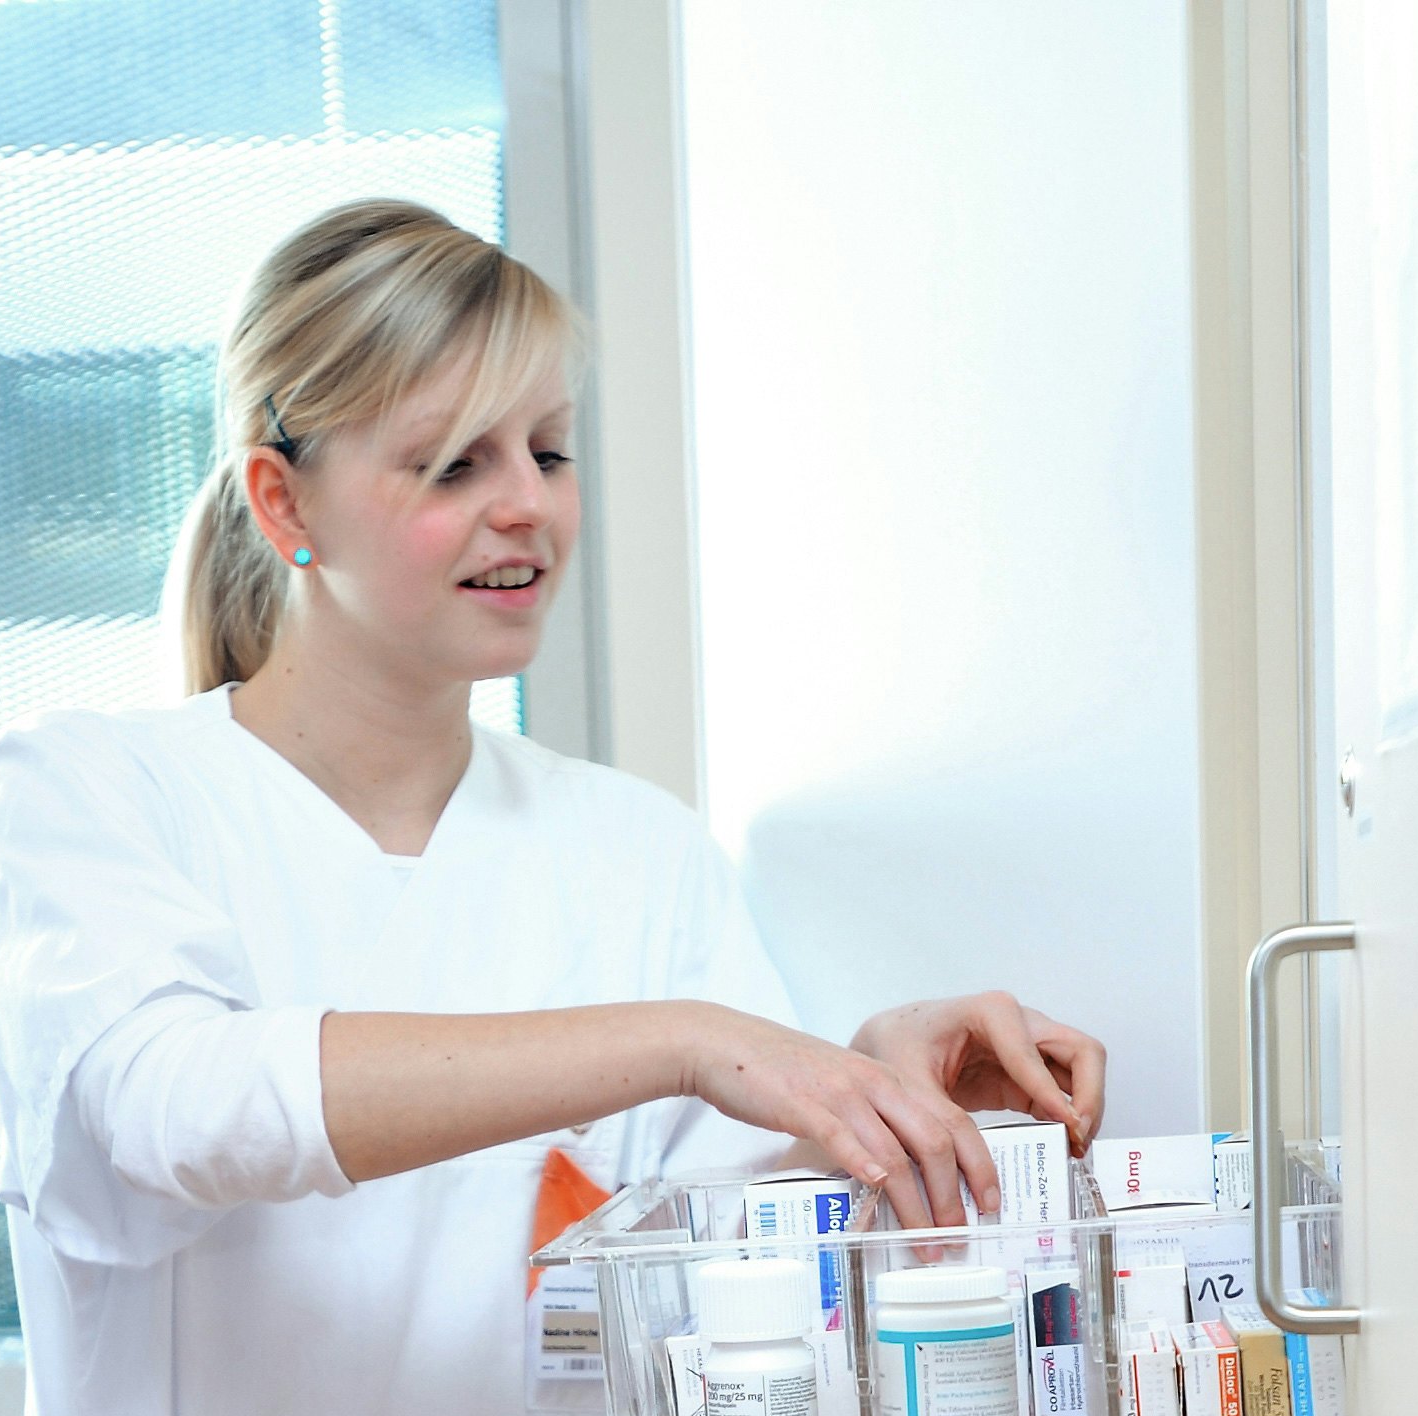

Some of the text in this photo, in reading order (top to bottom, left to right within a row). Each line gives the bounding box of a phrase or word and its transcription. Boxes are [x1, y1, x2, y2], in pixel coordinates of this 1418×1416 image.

[1270, 1368, 1283, 1406] Folsan
[748, 1393, 763, 1402] mg
[1228, 1401, 1238, 1416] 50
